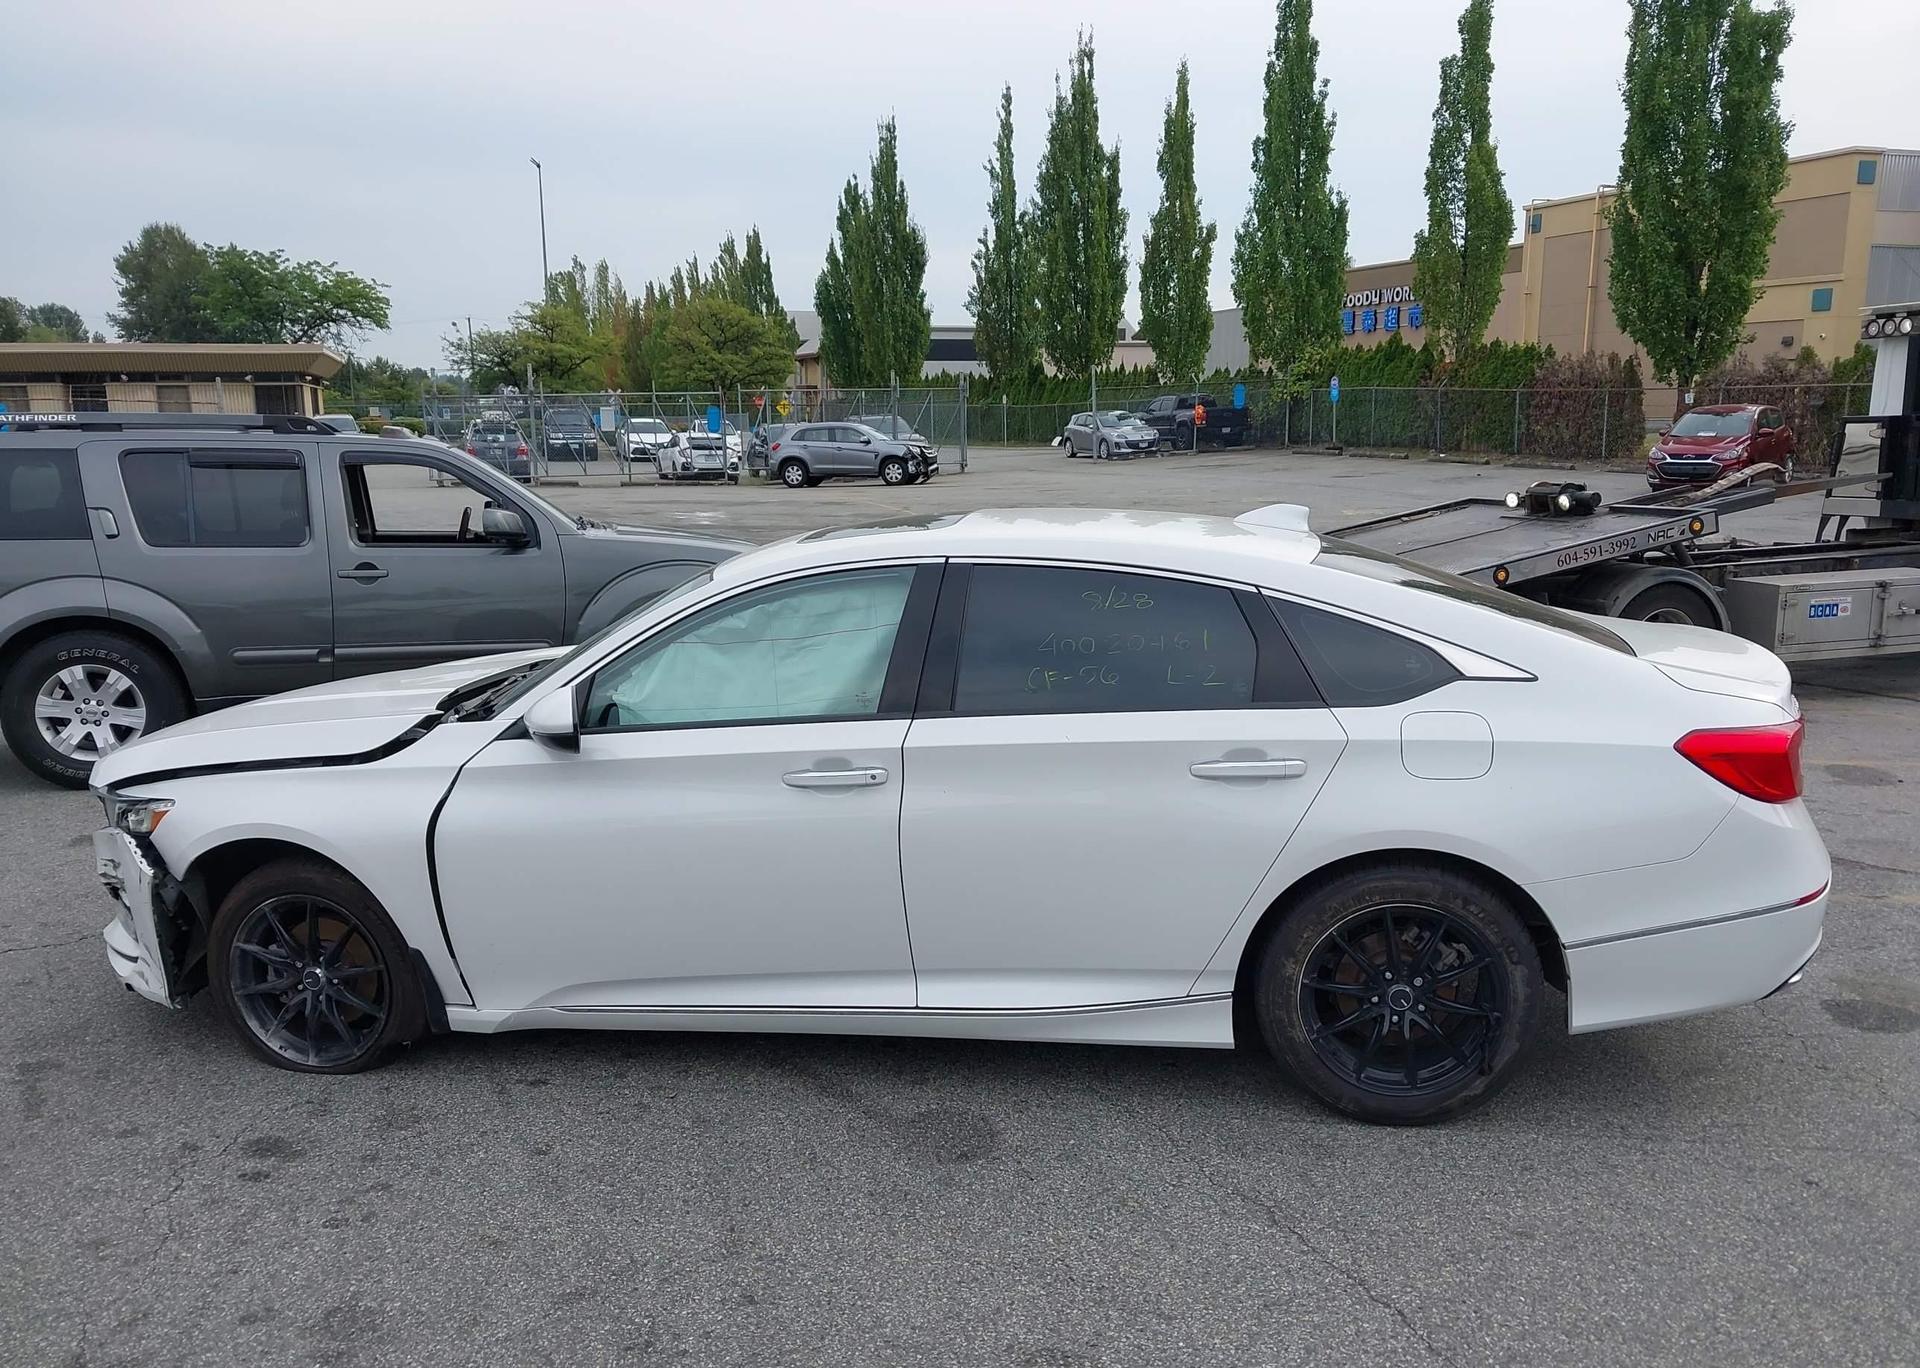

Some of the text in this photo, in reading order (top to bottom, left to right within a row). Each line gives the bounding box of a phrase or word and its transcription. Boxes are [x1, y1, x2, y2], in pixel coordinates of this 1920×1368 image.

[1383, 286, 1415, 303] WORL
[1557, 536, 1637, 568] 604-591-3992
[1810, 604, 1838, 617] BCAA
[57, 648, 140, 674] GENERAL
